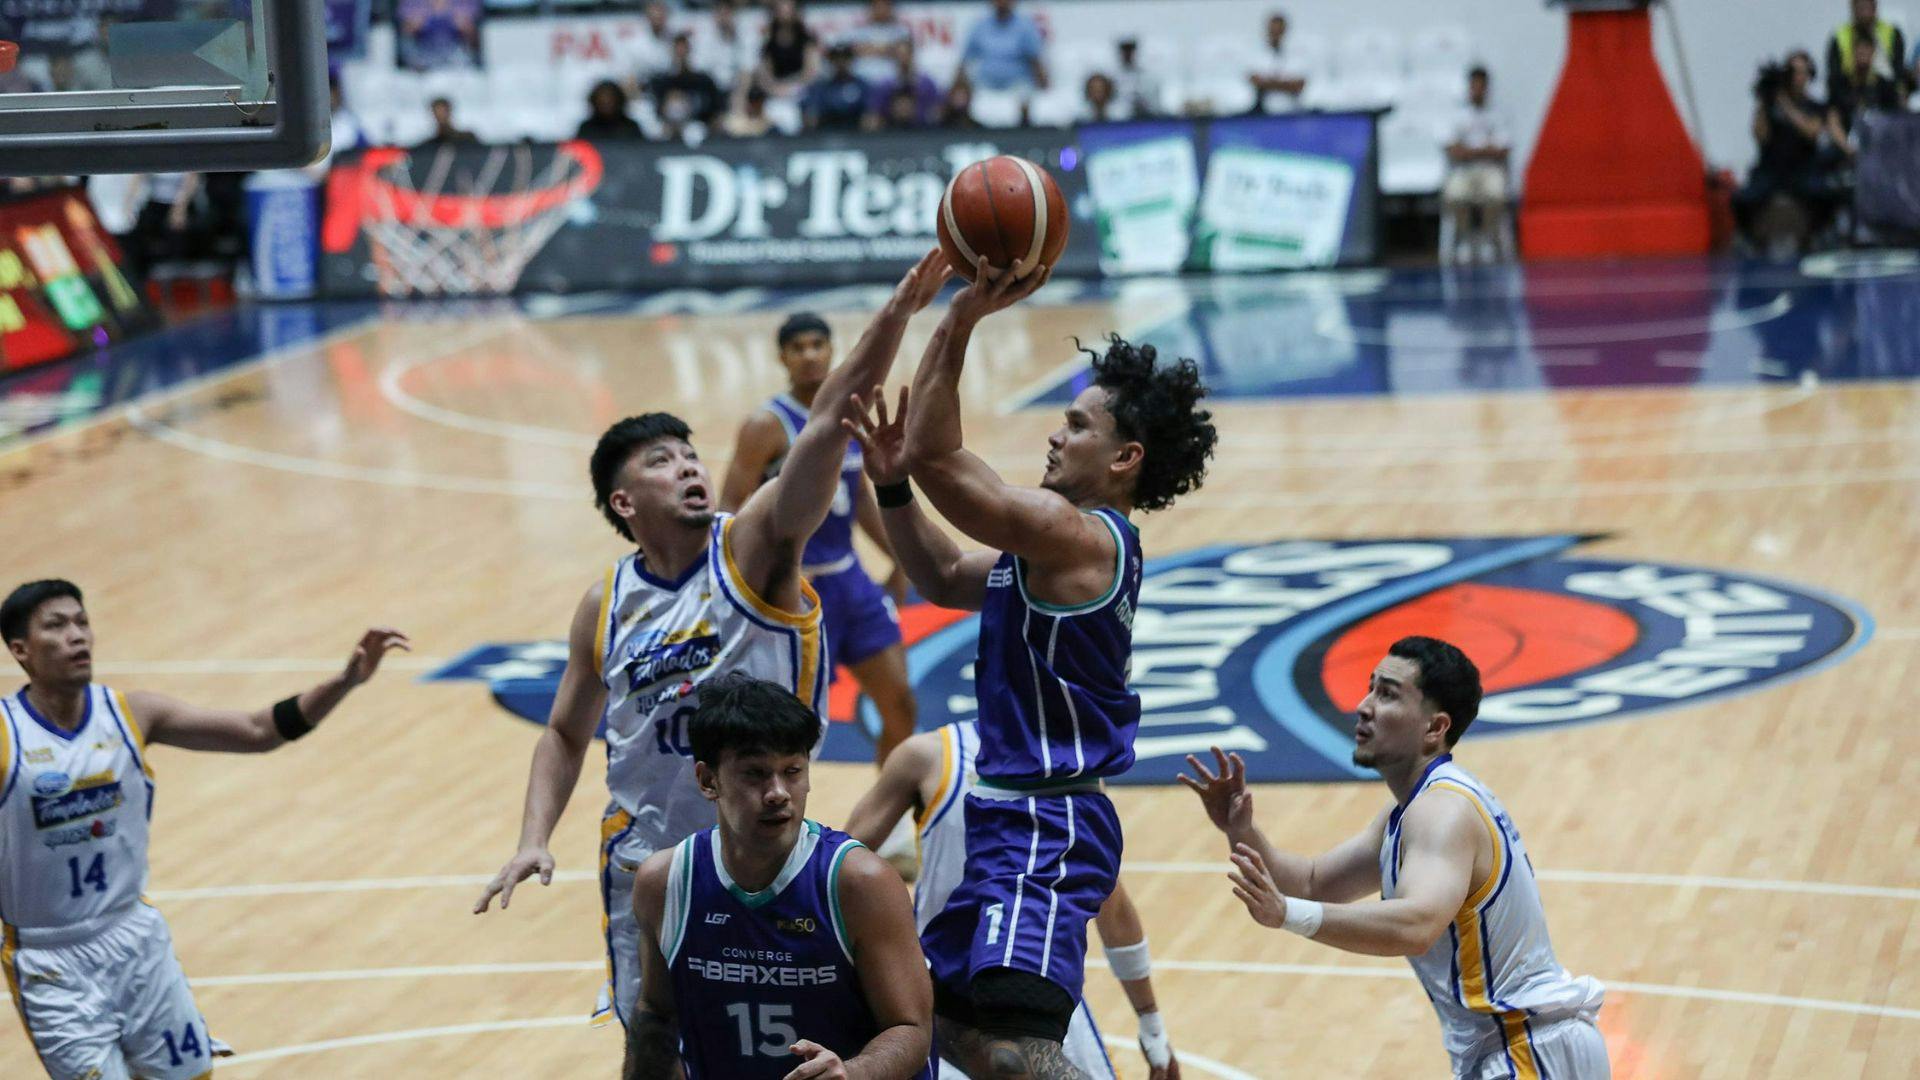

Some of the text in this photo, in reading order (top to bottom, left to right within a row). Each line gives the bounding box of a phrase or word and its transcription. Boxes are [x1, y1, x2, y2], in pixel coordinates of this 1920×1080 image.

[652, 154, 787, 241] Dr
[1476, 565, 1813, 724] CENTER
[68, 853, 108, 898] 14
[986, 903, 1004, 945] 1
[721, 947, 793, 962] CONVERGE
[162, 1022, 203, 1067] 14
[725, 1002, 799, 1057] 15
